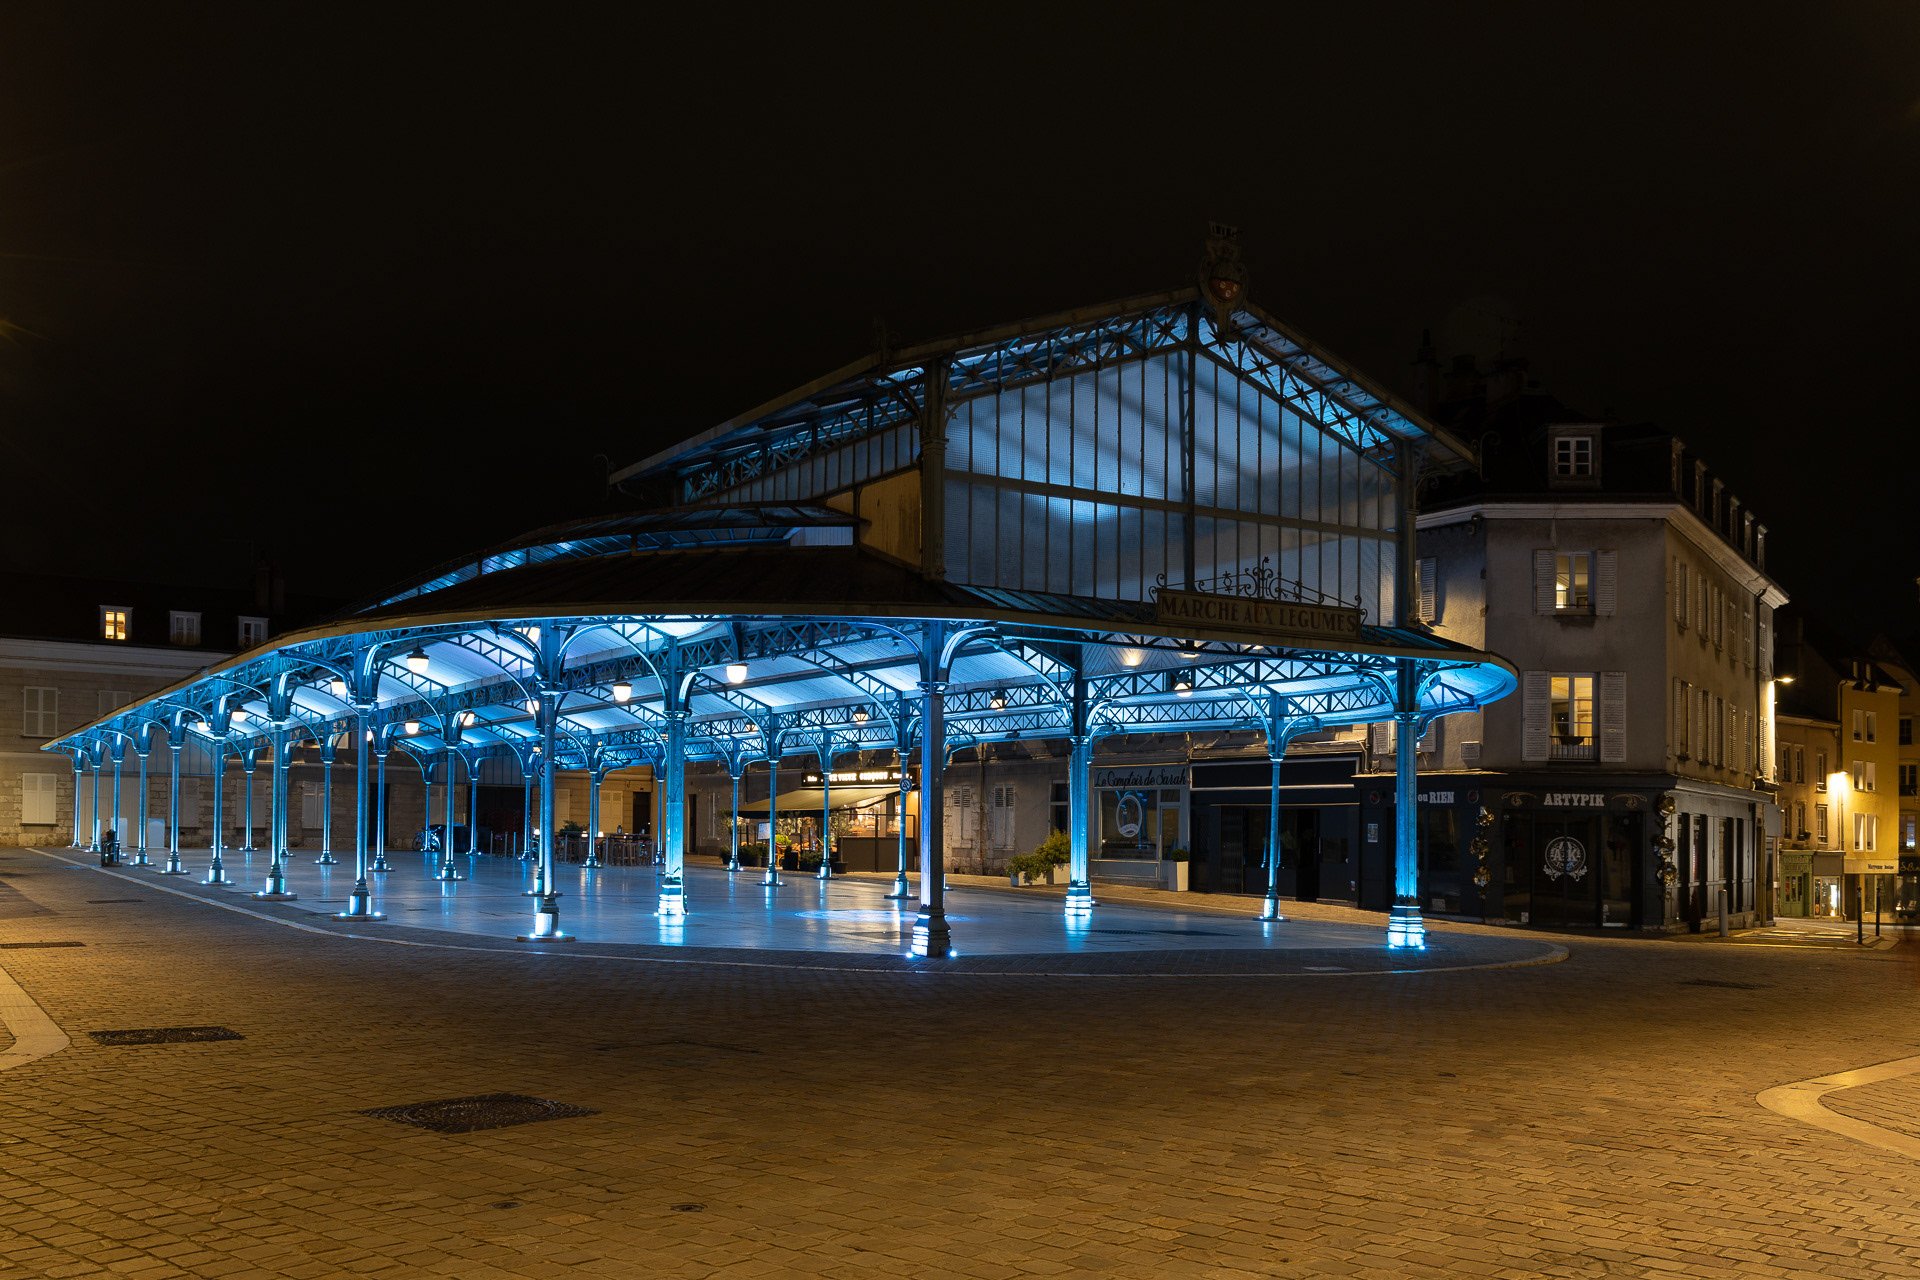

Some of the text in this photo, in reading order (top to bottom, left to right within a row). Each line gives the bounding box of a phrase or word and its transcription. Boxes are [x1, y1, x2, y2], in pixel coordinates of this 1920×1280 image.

[1244, 602, 1273, 624] AUX
[1095, 768, 1186, 789] Le Comptoir de Sarah
[1417, 791, 1455, 803] ou RIEN
[1543, 793, 1605, 806] ARTYPIK
